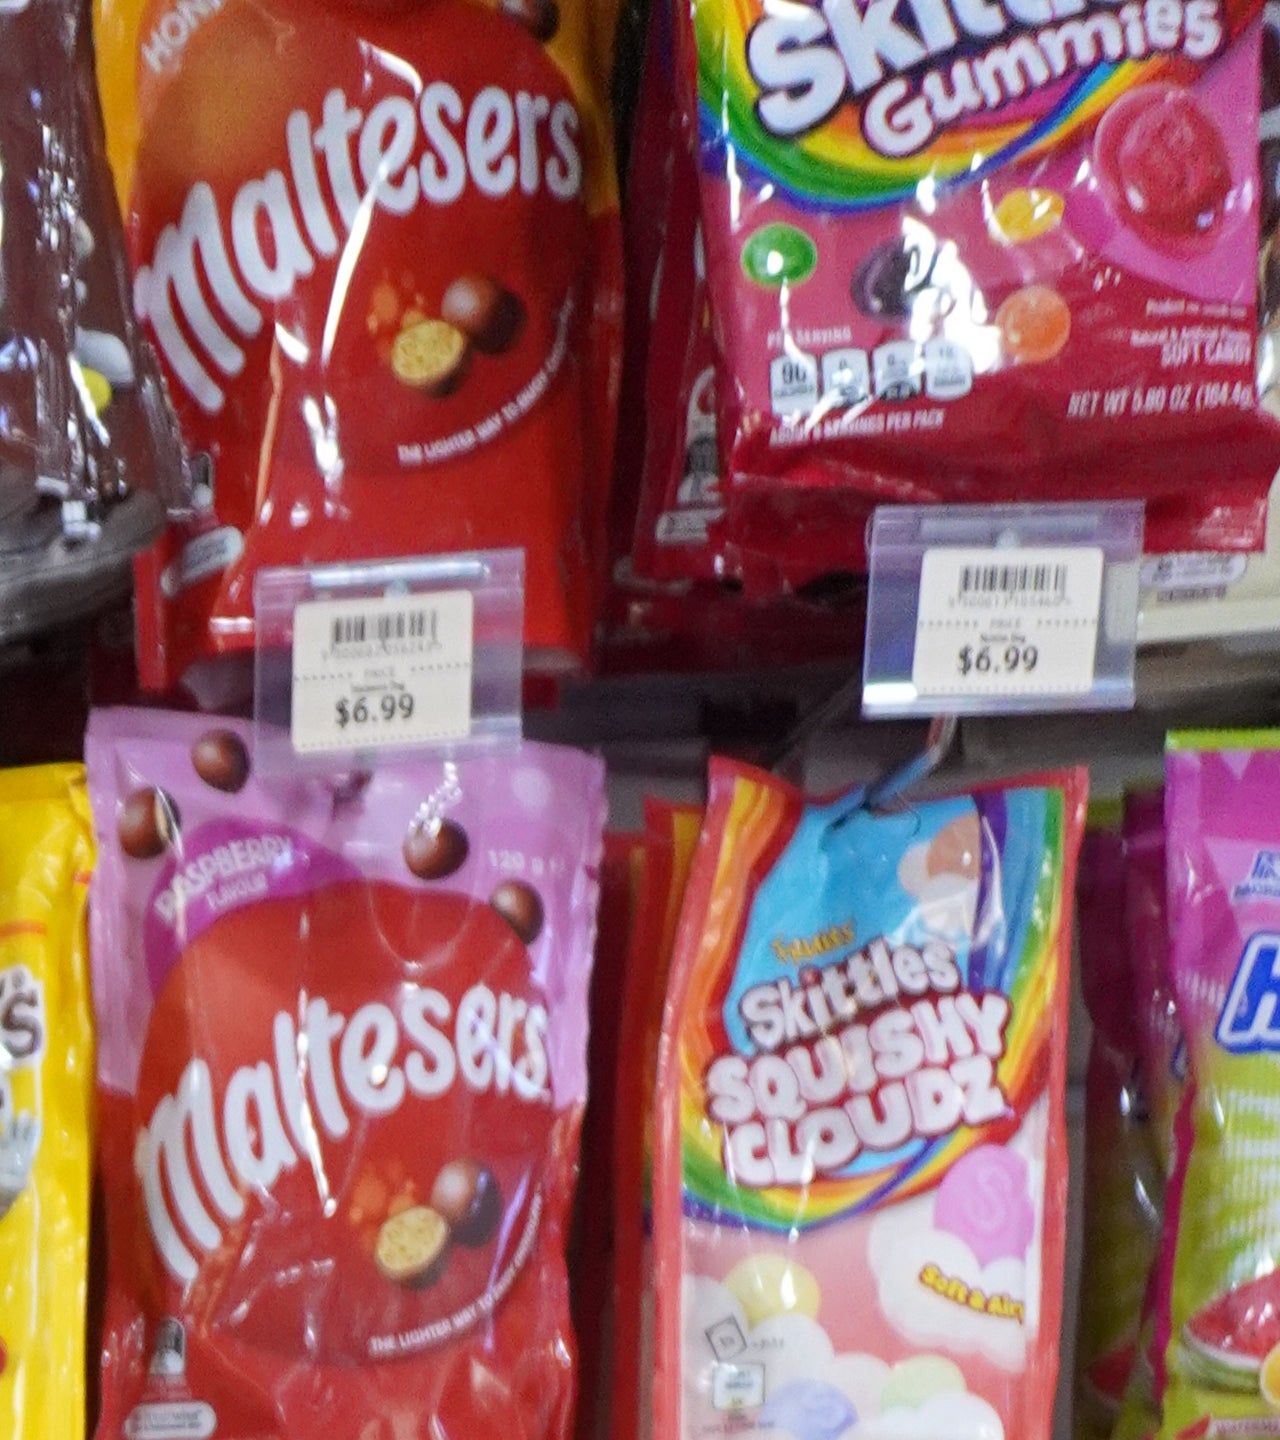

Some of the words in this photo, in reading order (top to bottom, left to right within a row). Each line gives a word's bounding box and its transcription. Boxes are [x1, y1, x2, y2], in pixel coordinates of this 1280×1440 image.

[861, 2, 1226, 158] Gummies
[134, 82, 582, 413] Maltesers
[335, 692, 415, 730] $6.99
[957, 645, 1039, 676] $6.99
[152, 834, 292, 926] RASPBERRY
[738, 937, 962, 1050] Skittles
[706, 990, 1011, 1126] SQUISHY
[133, 983, 554, 1284] Maltesers
[724, 1054, 1014, 1188] CLOUDZ
[368, 1332, 396, 1357] THE
[398, 1319, 452, 1352] LIGHTER
[919, 1262, 962, 1304] Soft
